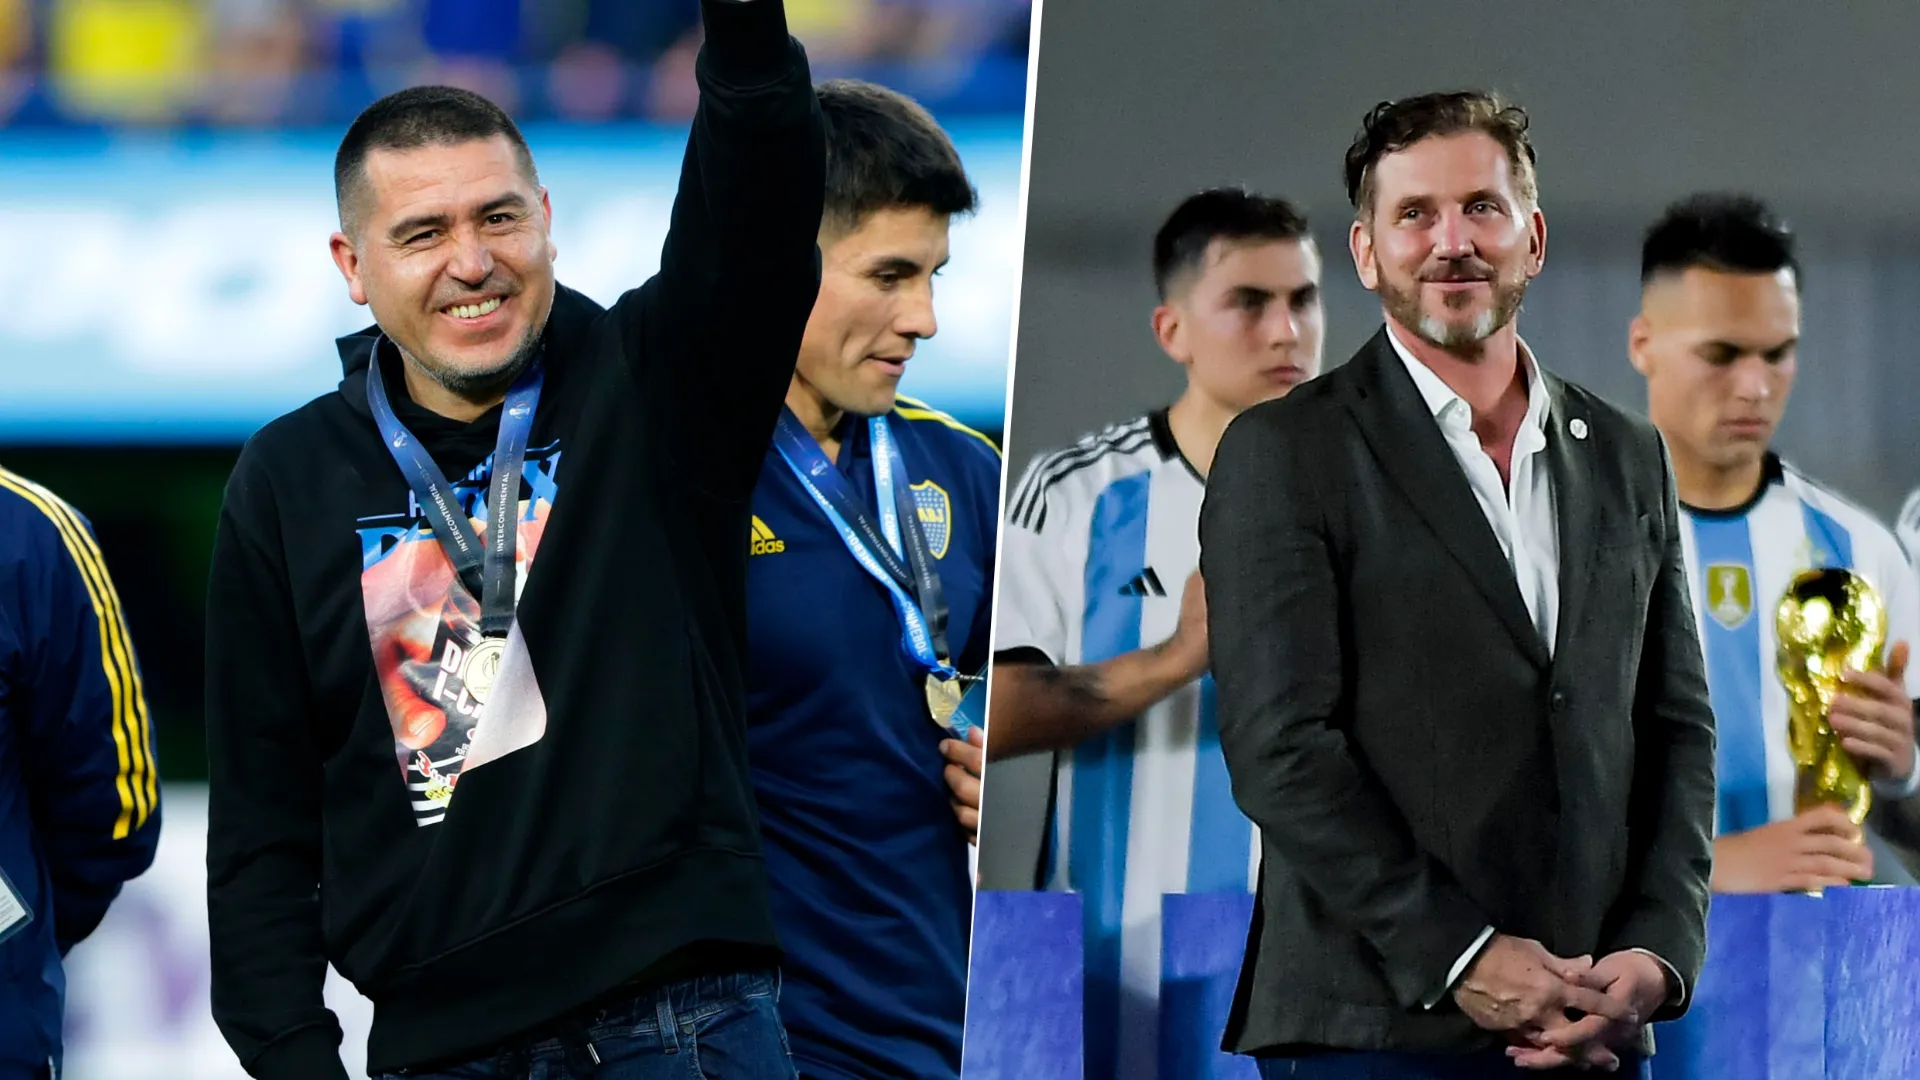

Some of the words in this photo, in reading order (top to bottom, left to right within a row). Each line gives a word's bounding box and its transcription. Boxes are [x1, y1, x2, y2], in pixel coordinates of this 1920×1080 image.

[428, 483, 469, 552] INTERCONTINENTAL
[497, 472, 510, 552] INTERCONTINENTAL
[750, 539, 785, 555] idas
[903, 600, 929, 657] CONMEBOL
